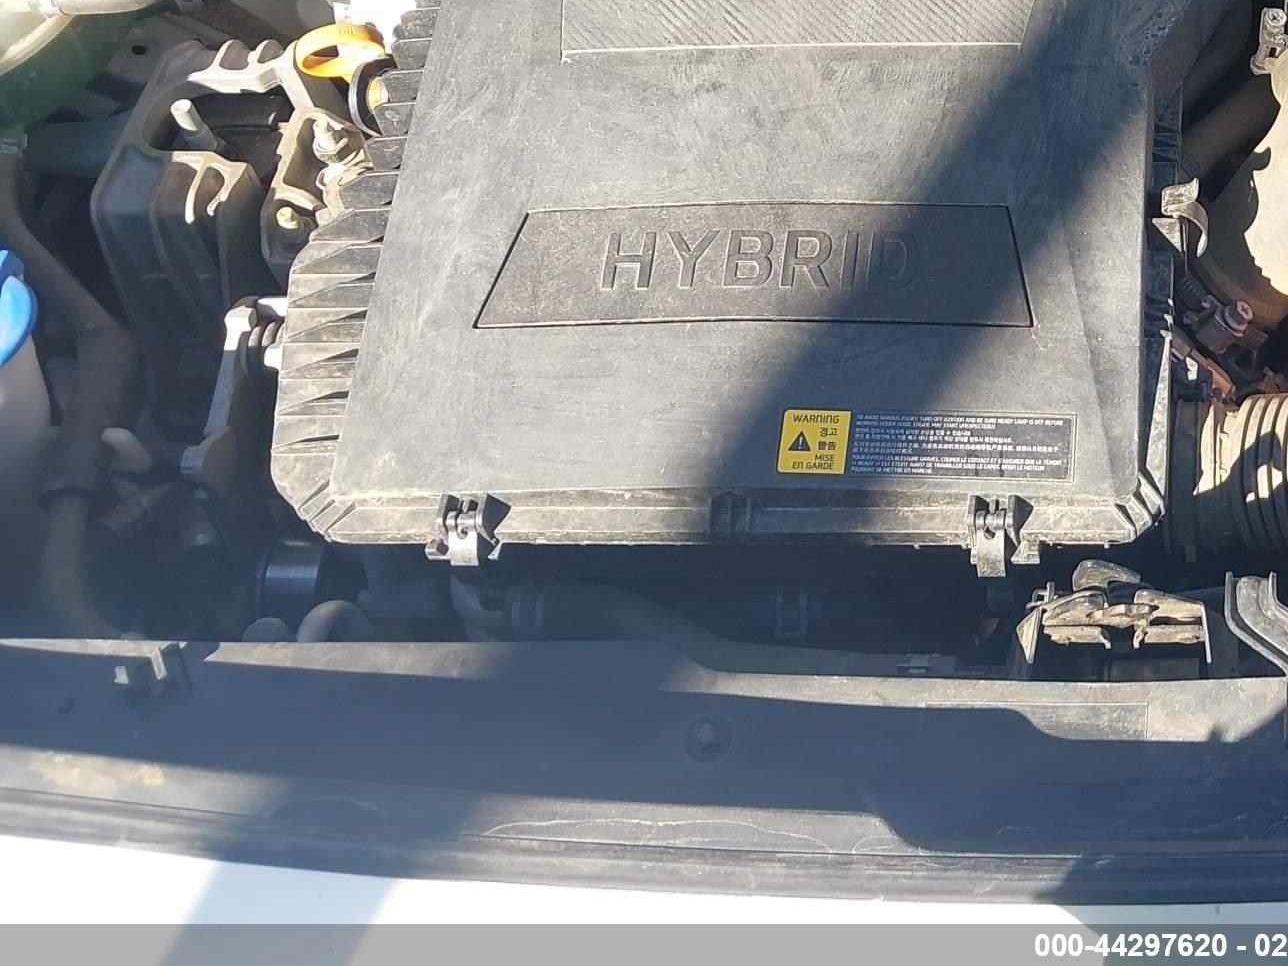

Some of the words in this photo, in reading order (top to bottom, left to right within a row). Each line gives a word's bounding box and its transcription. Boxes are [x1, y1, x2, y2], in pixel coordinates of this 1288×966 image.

[600, 228, 921, 292] HYBRID
[793, 414, 840, 424] WARNING
[819, 426, 838, 438] 경고
[815, 453, 836, 462] MISE
[792, 461, 804, 470] EN
[806, 461, 835, 470] GARDE
